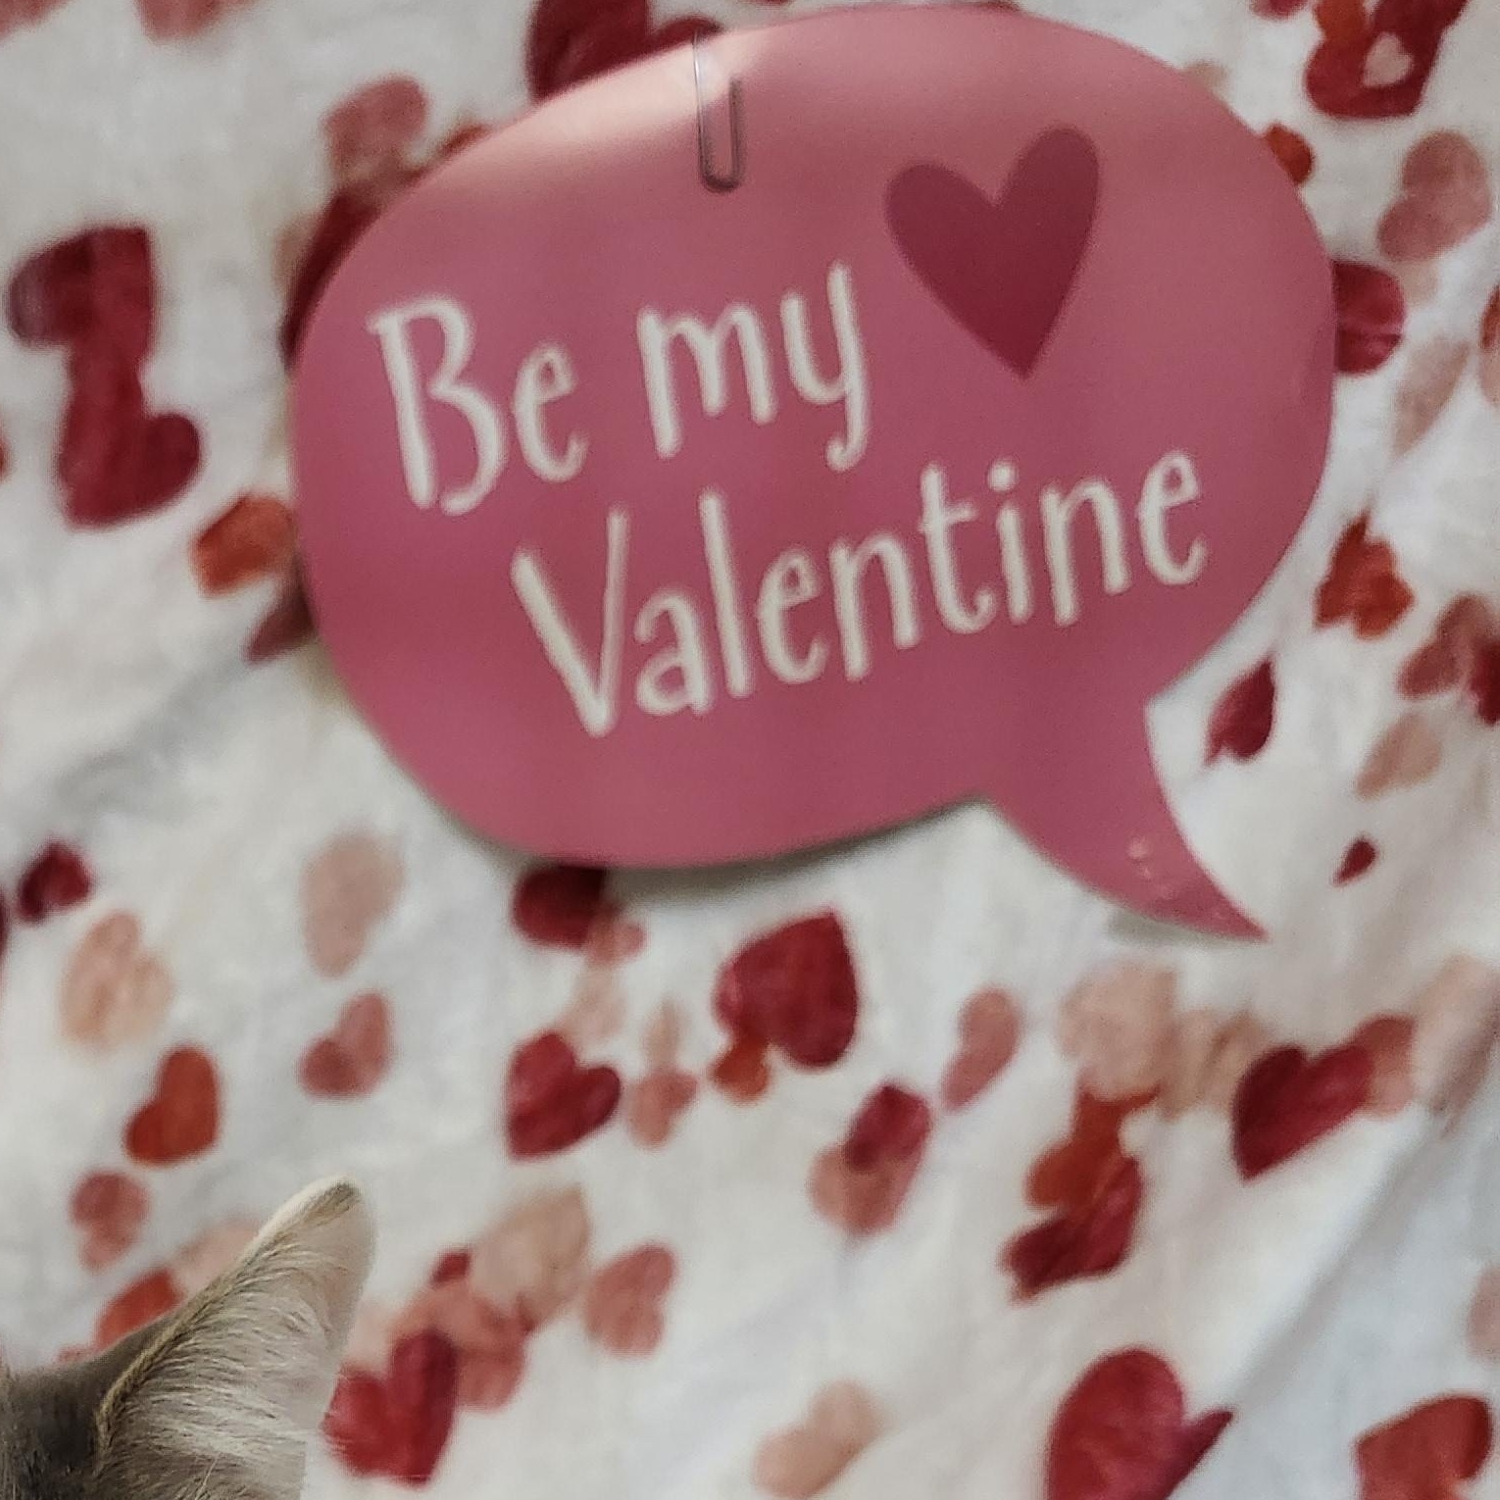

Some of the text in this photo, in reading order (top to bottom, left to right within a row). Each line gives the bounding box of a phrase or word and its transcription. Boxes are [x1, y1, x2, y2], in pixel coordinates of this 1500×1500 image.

[366, 261, 871, 515] Be my
[510, 450, 1208, 738] Valentine
